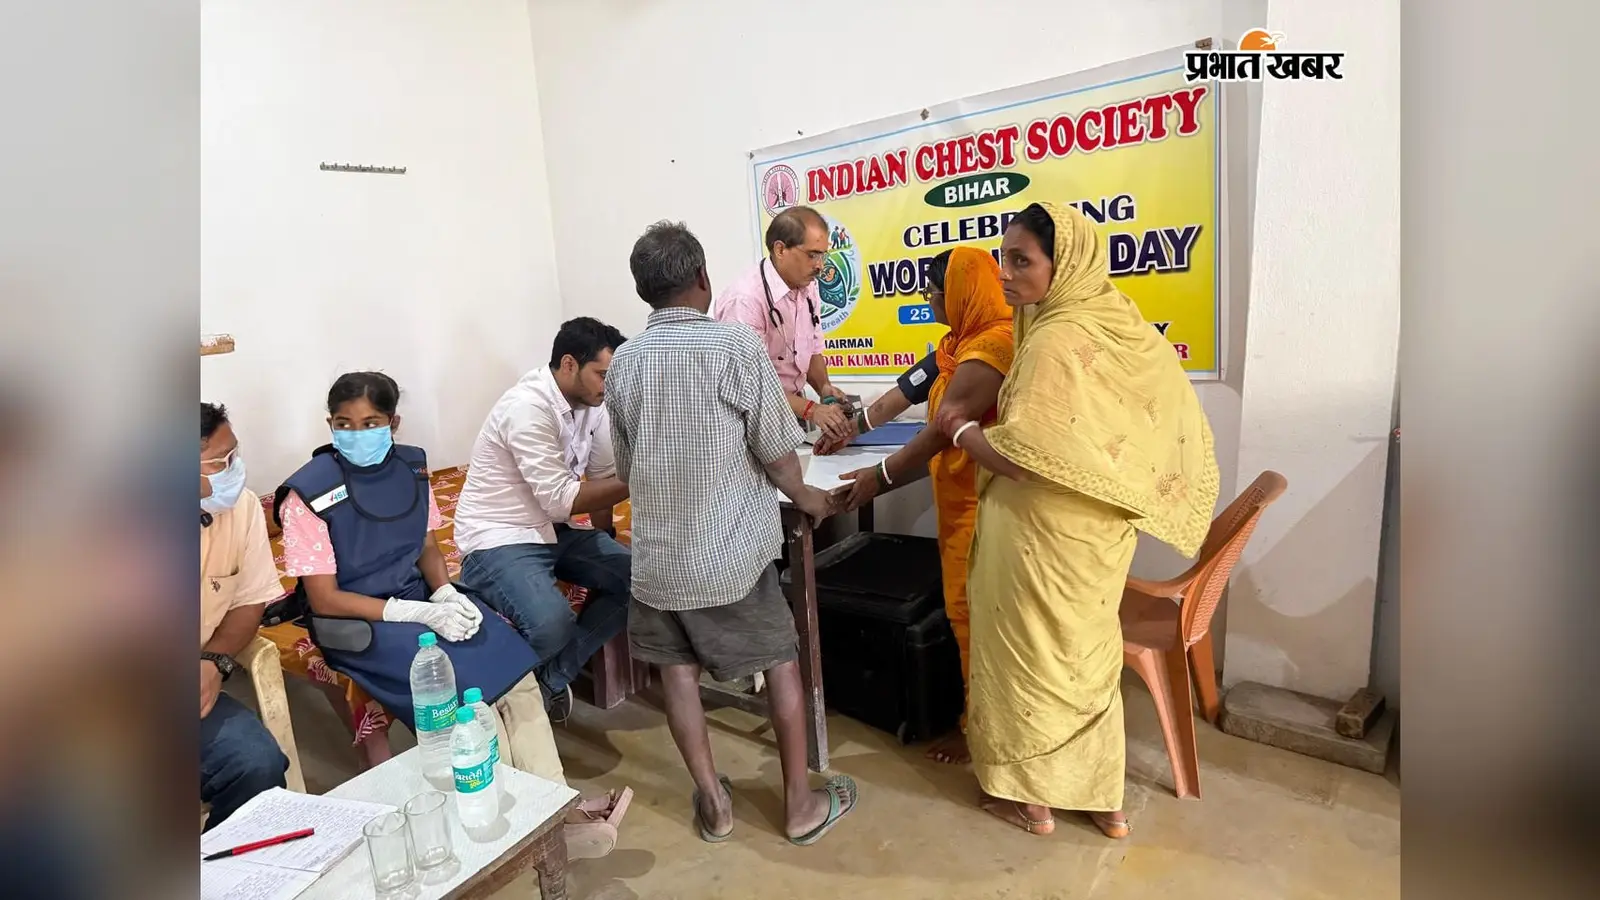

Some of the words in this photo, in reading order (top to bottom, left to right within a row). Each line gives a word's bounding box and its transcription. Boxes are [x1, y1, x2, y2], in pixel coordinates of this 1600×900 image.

[806, 150, 908, 202] INDIAN
[914, 126, 1019, 181] CHEST
[1025, 87, 1207, 161] SOCIETY
[943, 175, 1010, 205] BIHAR
[1108, 225, 1199, 274] DAY
[820, 310, 850, 331] Breath
[910, 307, 931, 321] 25
[847, 353, 890, 367] KUMAR
[893, 353, 915, 366] RAI
